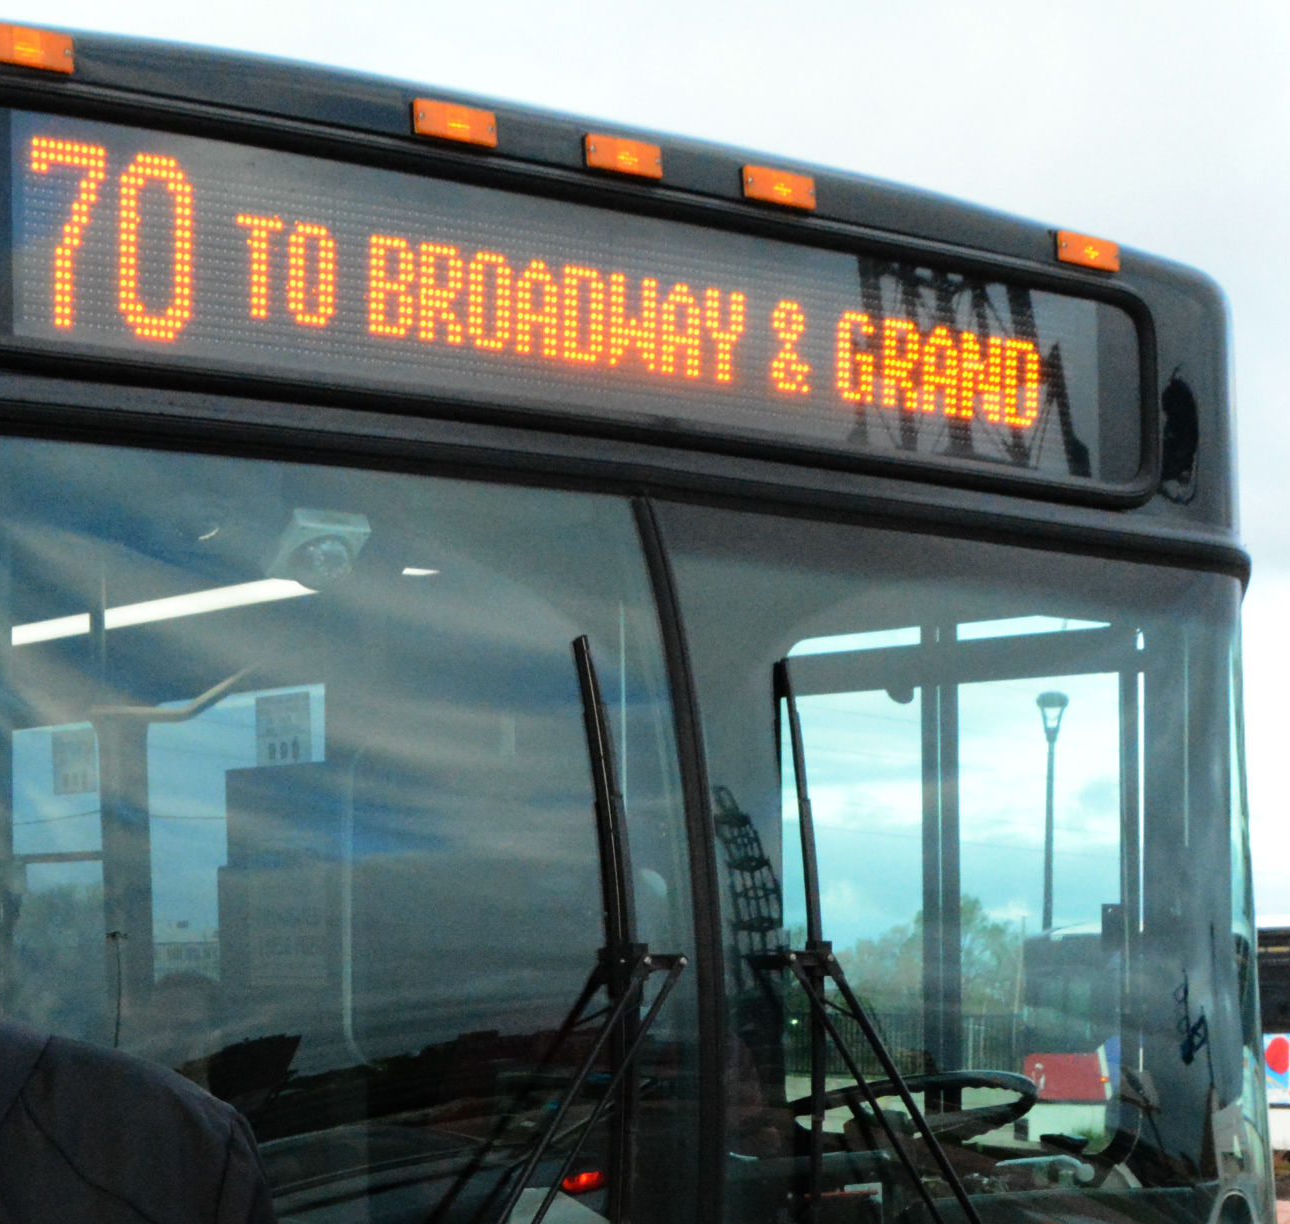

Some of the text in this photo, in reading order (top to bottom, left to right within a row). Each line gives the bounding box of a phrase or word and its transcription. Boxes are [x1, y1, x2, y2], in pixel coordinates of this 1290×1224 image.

[30, 135, 1041, 428] 70 TO BROADWAY & GRAND
